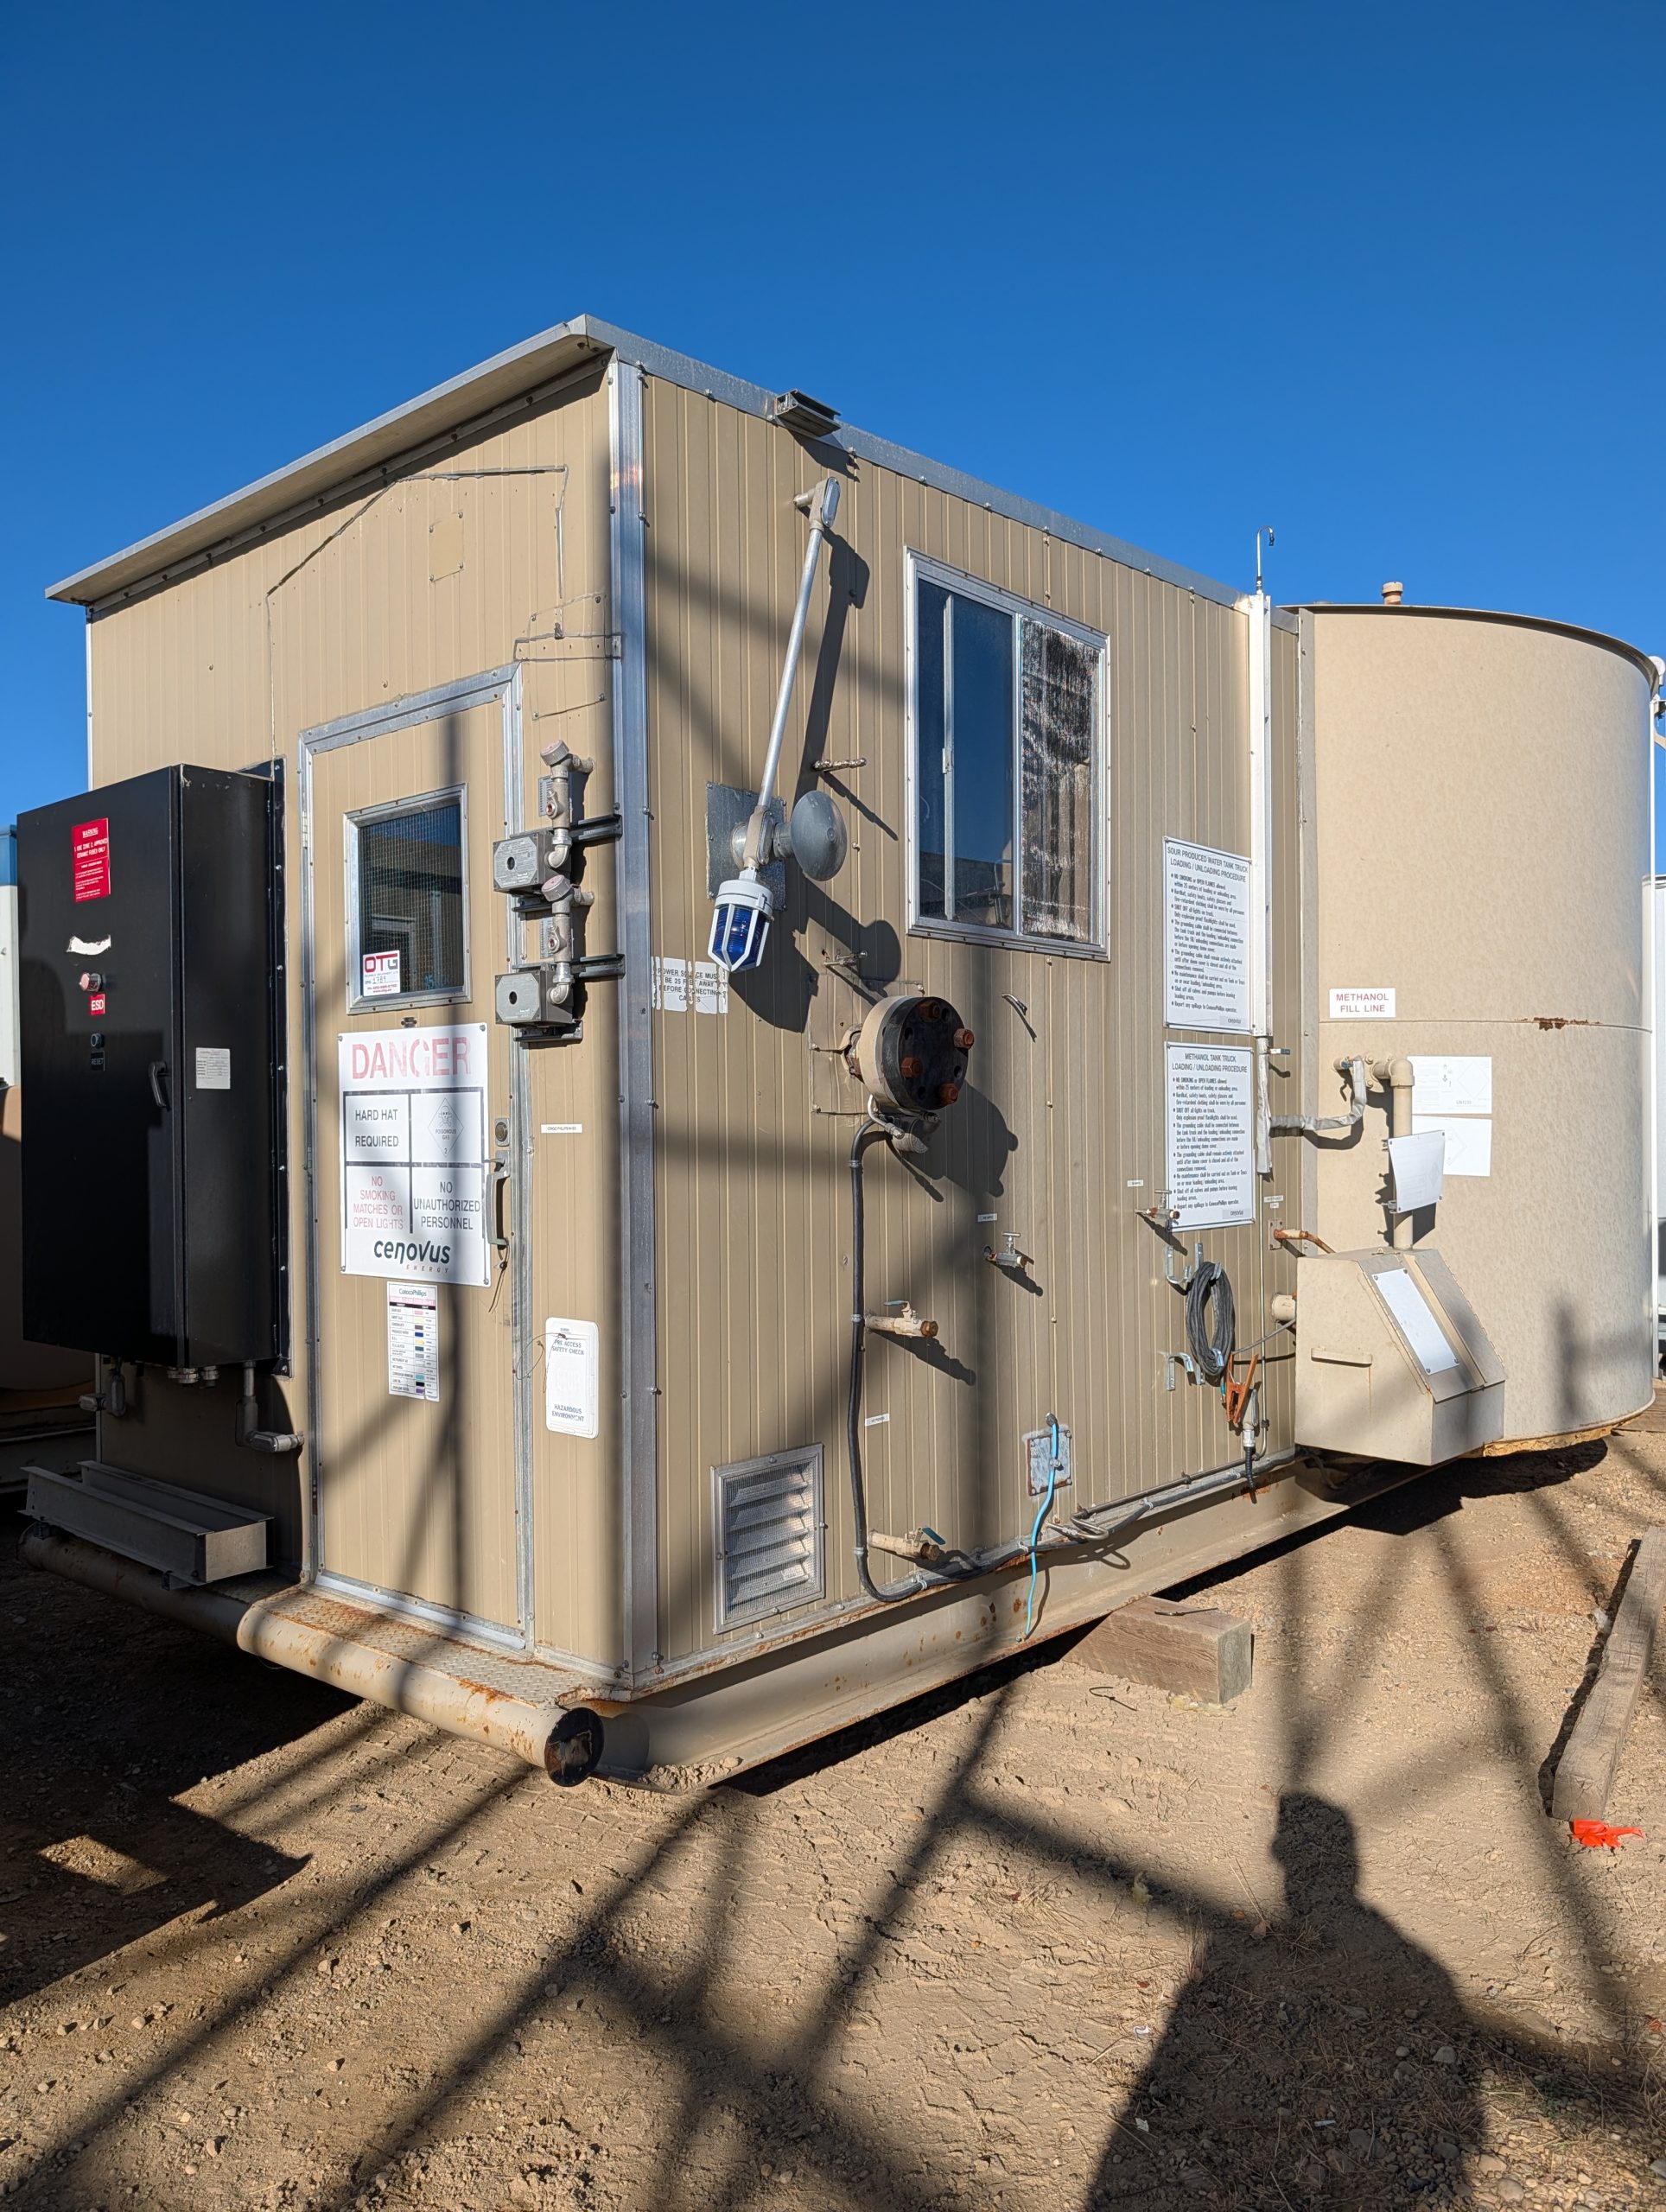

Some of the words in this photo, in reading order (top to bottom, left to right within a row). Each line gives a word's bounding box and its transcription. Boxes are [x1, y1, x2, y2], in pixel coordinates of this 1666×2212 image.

[1167, 847, 1180, 856] SOUR
[1182, 850, 1206, 862] PRODUCED
[1208, 856, 1222, 867] WATER
[1224, 861, 1233, 869] TANK
[1235, 863, 1248, 873] TRUCK
[1171, 858, 1191, 869] LOADING
[1195, 864, 1220, 876] UNLOADING
[1221, 870, 1246, 882] PROCEDURE
[365, 953, 397, 973] OTG
[658, 968, 678, 976] POWER
[1336, 993, 1389, 1001] METHANOL
[91, 999, 104, 1011] ESD
[1364, 1004, 1385, 1013] LINE
[353, 1037, 471, 1079] DANGER
[355, 1109, 378, 1121] HARD
[381, 1109, 398, 1121] HAT
[355, 1135, 399, 1147] REQUIRED
[372, 1176, 383, 1187] NO
[440, 1181, 453, 1193] NO
[359, 1190, 396, 1201] SMOKING
[353, 1204, 388, 1215] MATCHES
[391, 1205, 403, 1215] OR
[414, 1198, 480, 1212] UNAUTHORIZED
[353, 1217, 373, 1229] OPEN
[377, 1217, 404, 1230] LIGHTS
[421, 1217, 474, 1230] PERSONNEL
[373, 1240, 451, 1264] cenovus
[406, 1264, 449, 1273] ENERGY
[554, 1403, 582, 1414] HAZARDOUS
